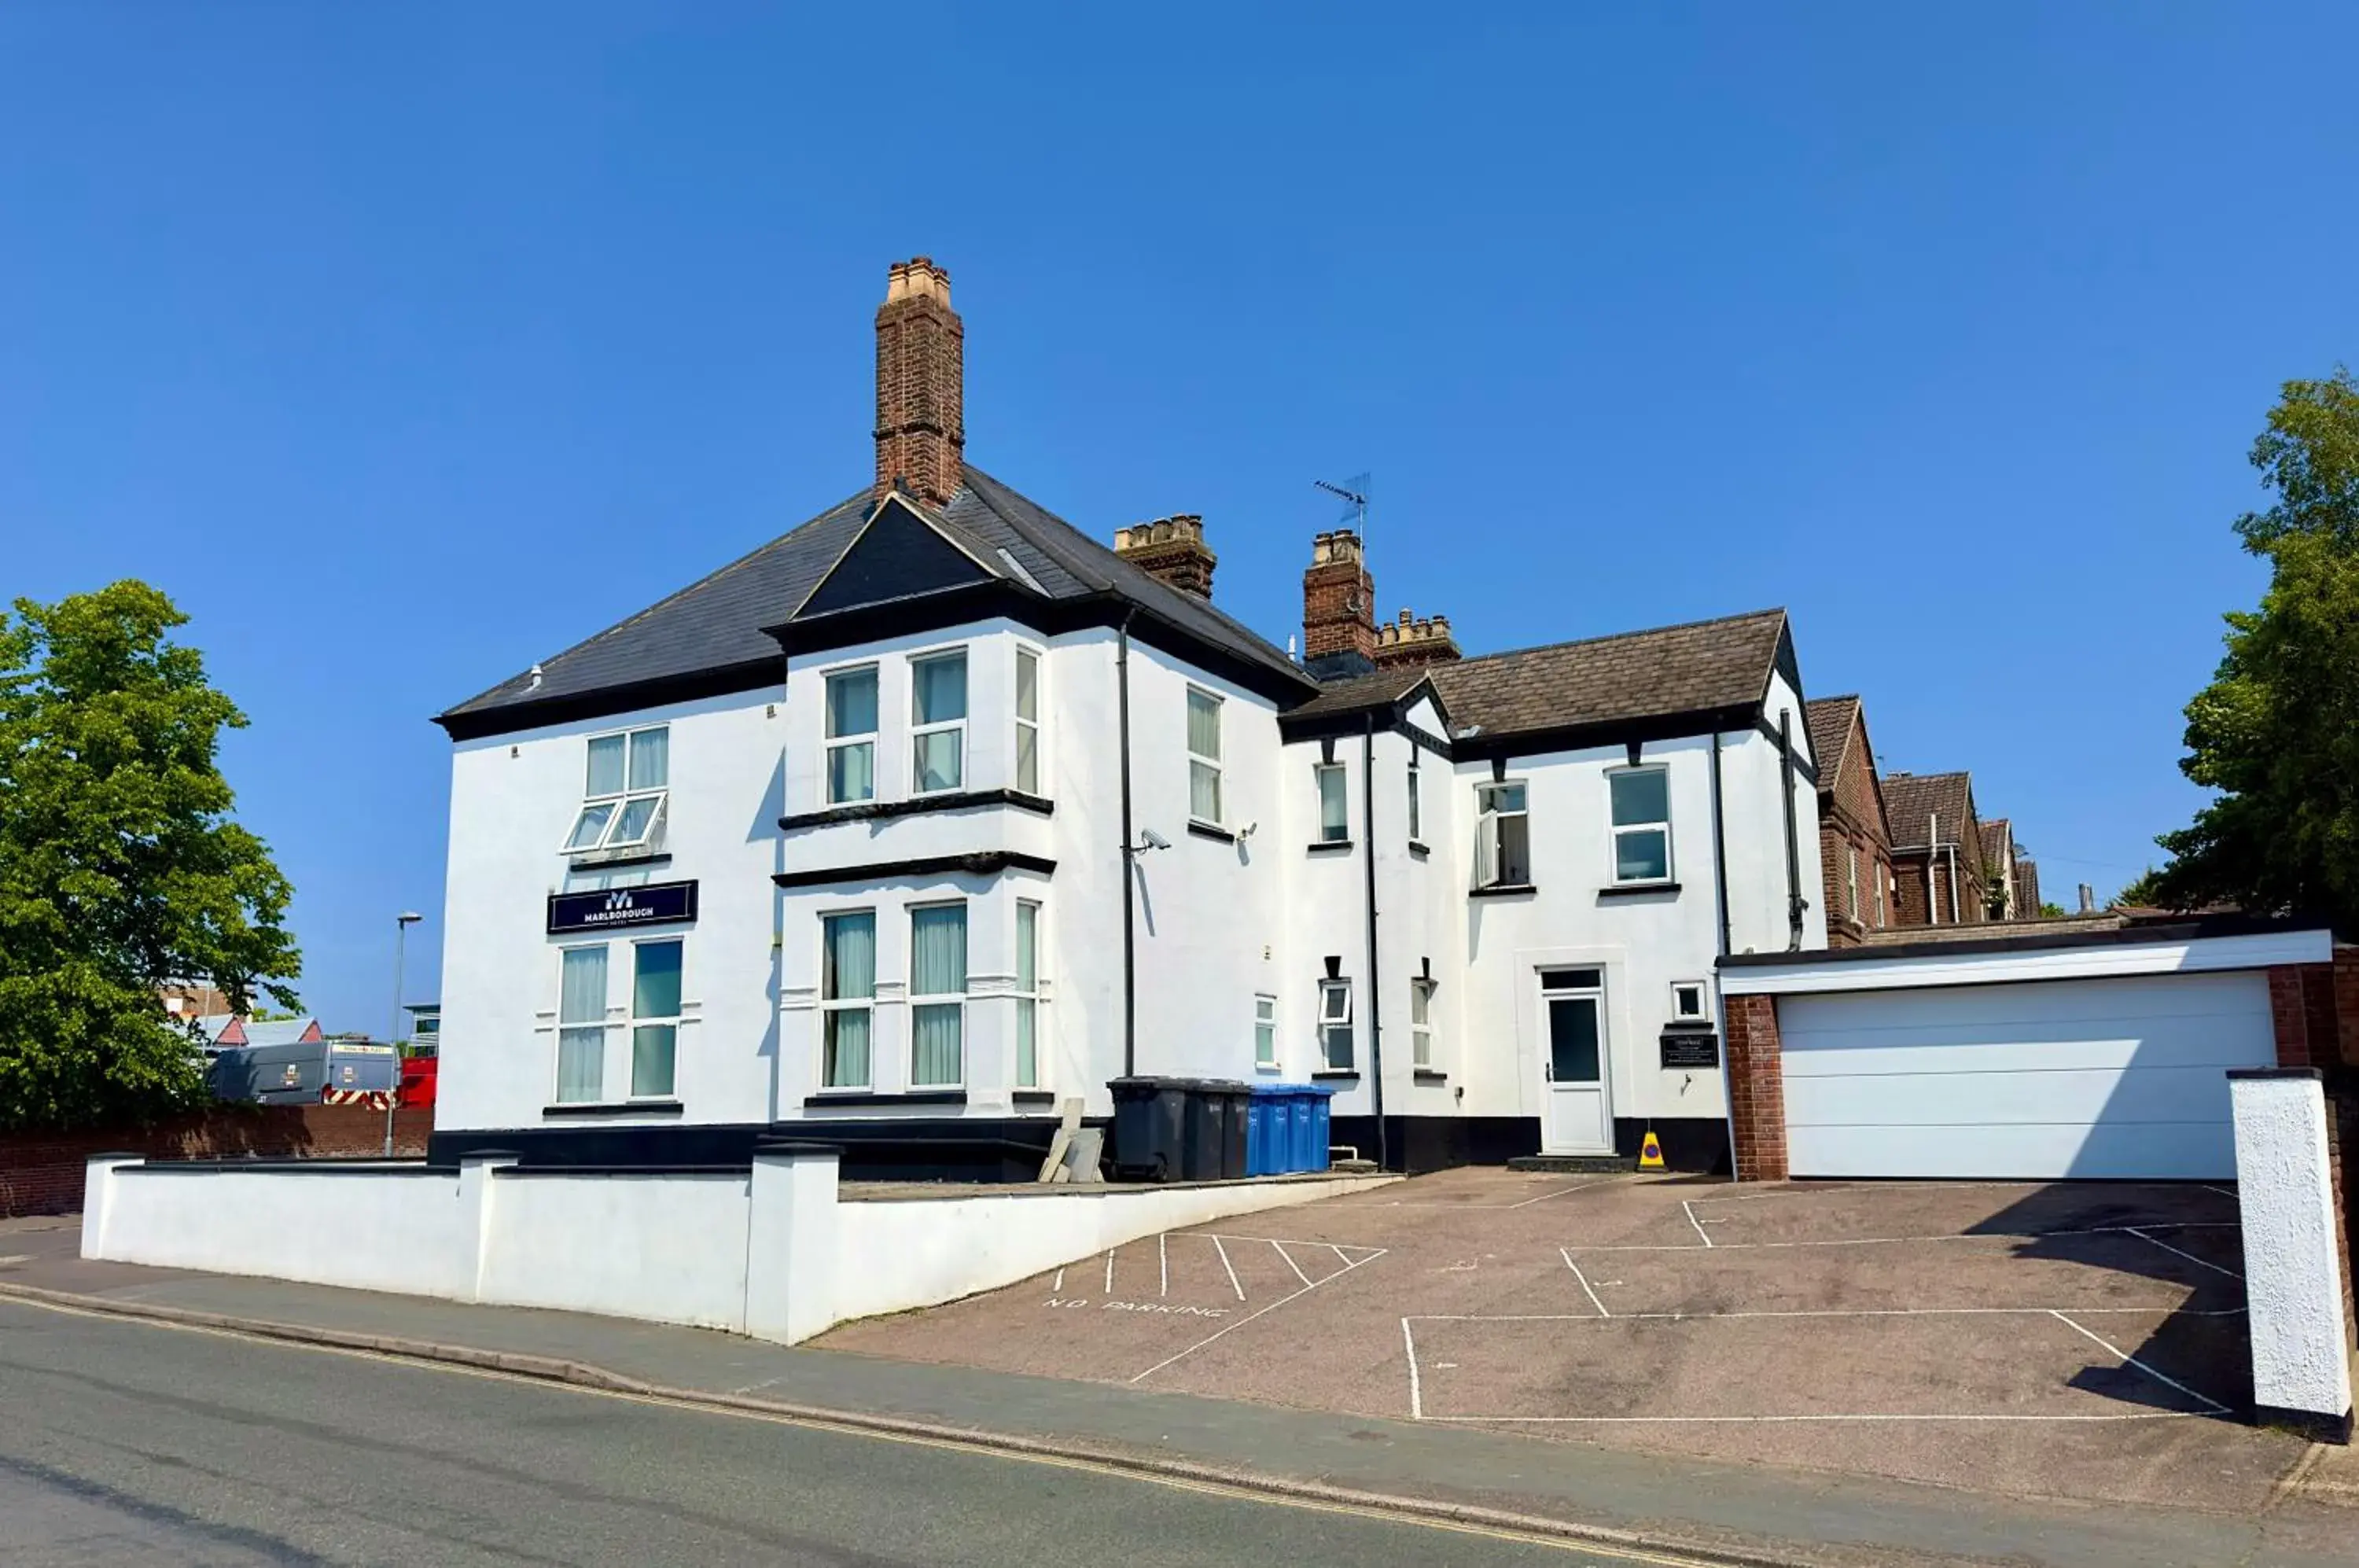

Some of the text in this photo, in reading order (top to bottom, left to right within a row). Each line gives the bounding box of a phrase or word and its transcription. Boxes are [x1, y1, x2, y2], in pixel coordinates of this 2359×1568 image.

[584, 907, 653, 922] MARLBOROUGH
[1042, 1298, 1230, 1317] NO PARKING
